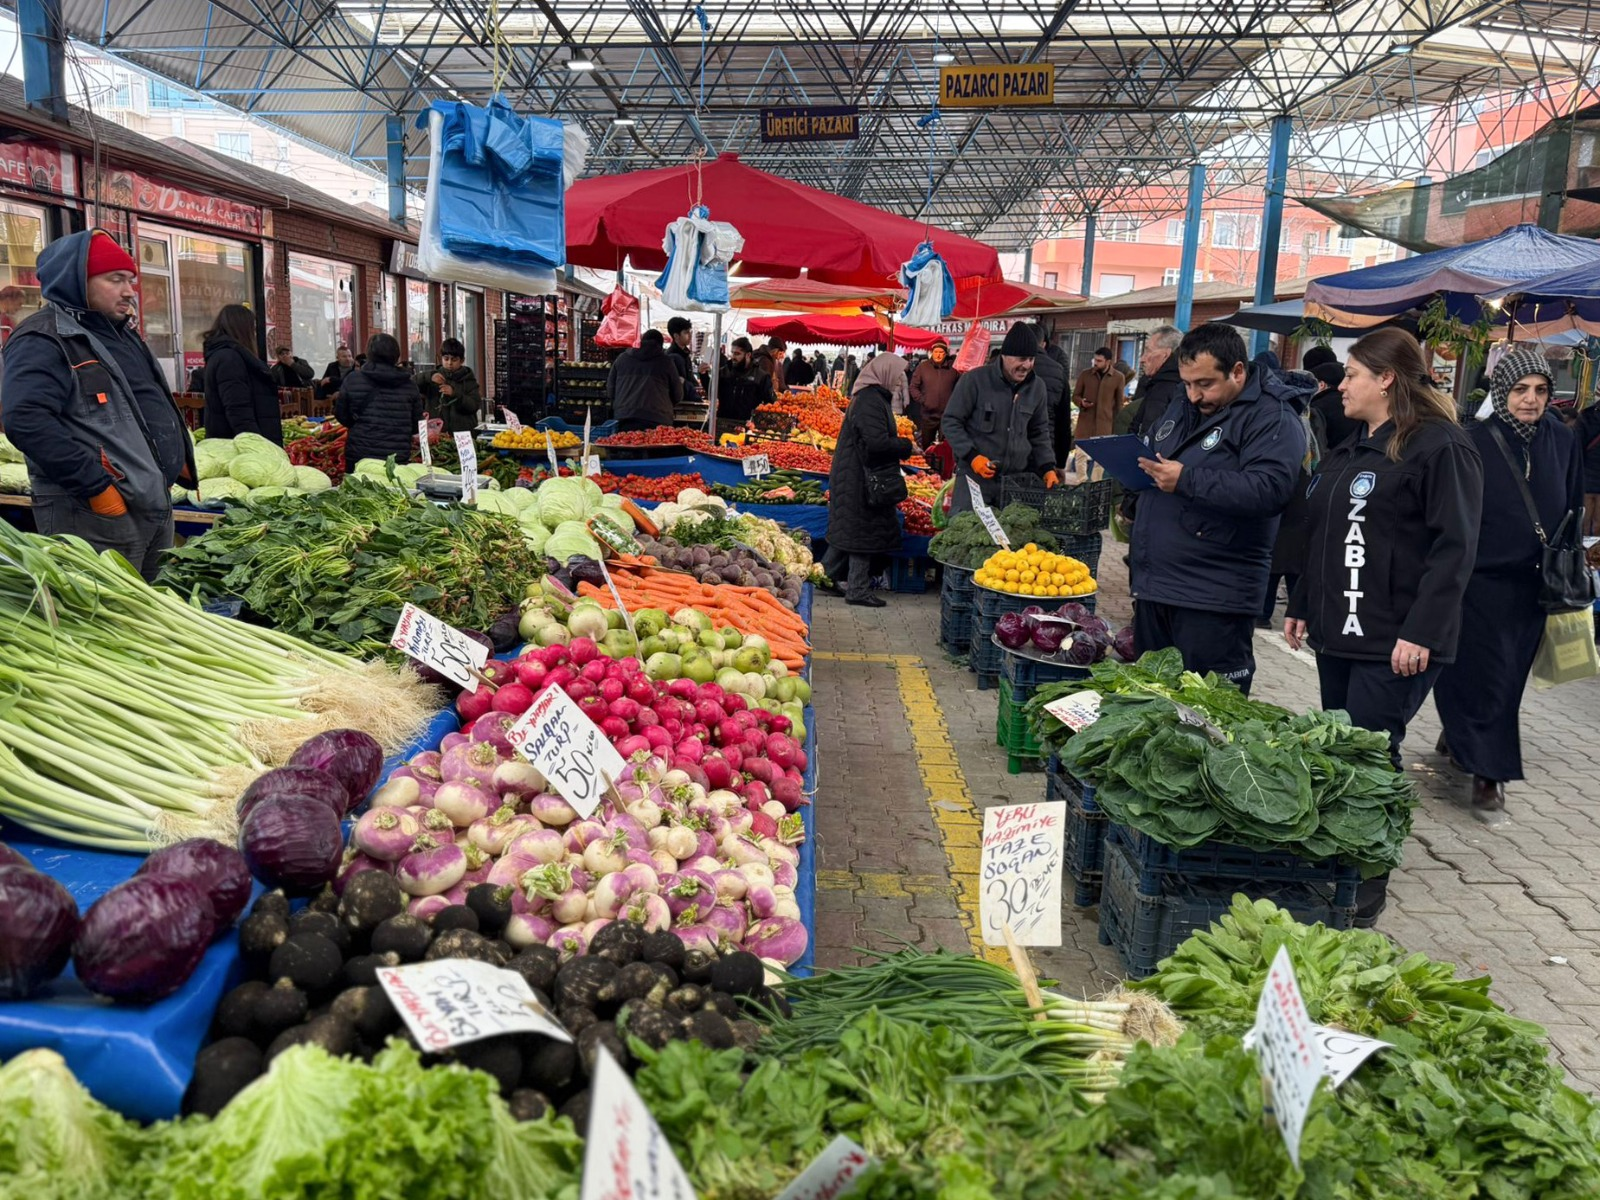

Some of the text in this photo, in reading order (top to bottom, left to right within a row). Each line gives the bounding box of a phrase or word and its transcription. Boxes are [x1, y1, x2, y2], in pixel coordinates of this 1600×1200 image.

[946, 71, 1049, 98] PAZARCI PAZARI
[766, 111, 853, 137] ÜRETİCİ PAZARI
[217, 208, 240, 223] CAFE
[930, 322, 963, 334] KAFKAS
[1341, 498, 1367, 637] ZABITA
[431, 642, 471, 682] 50
[543, 720, 572, 762] TURP
[555, 750, 595, 800] 50
[986, 832, 1047, 861] TAZE
[986, 876, 1028, 931] 30
[433, 974, 484, 1018] TURP
